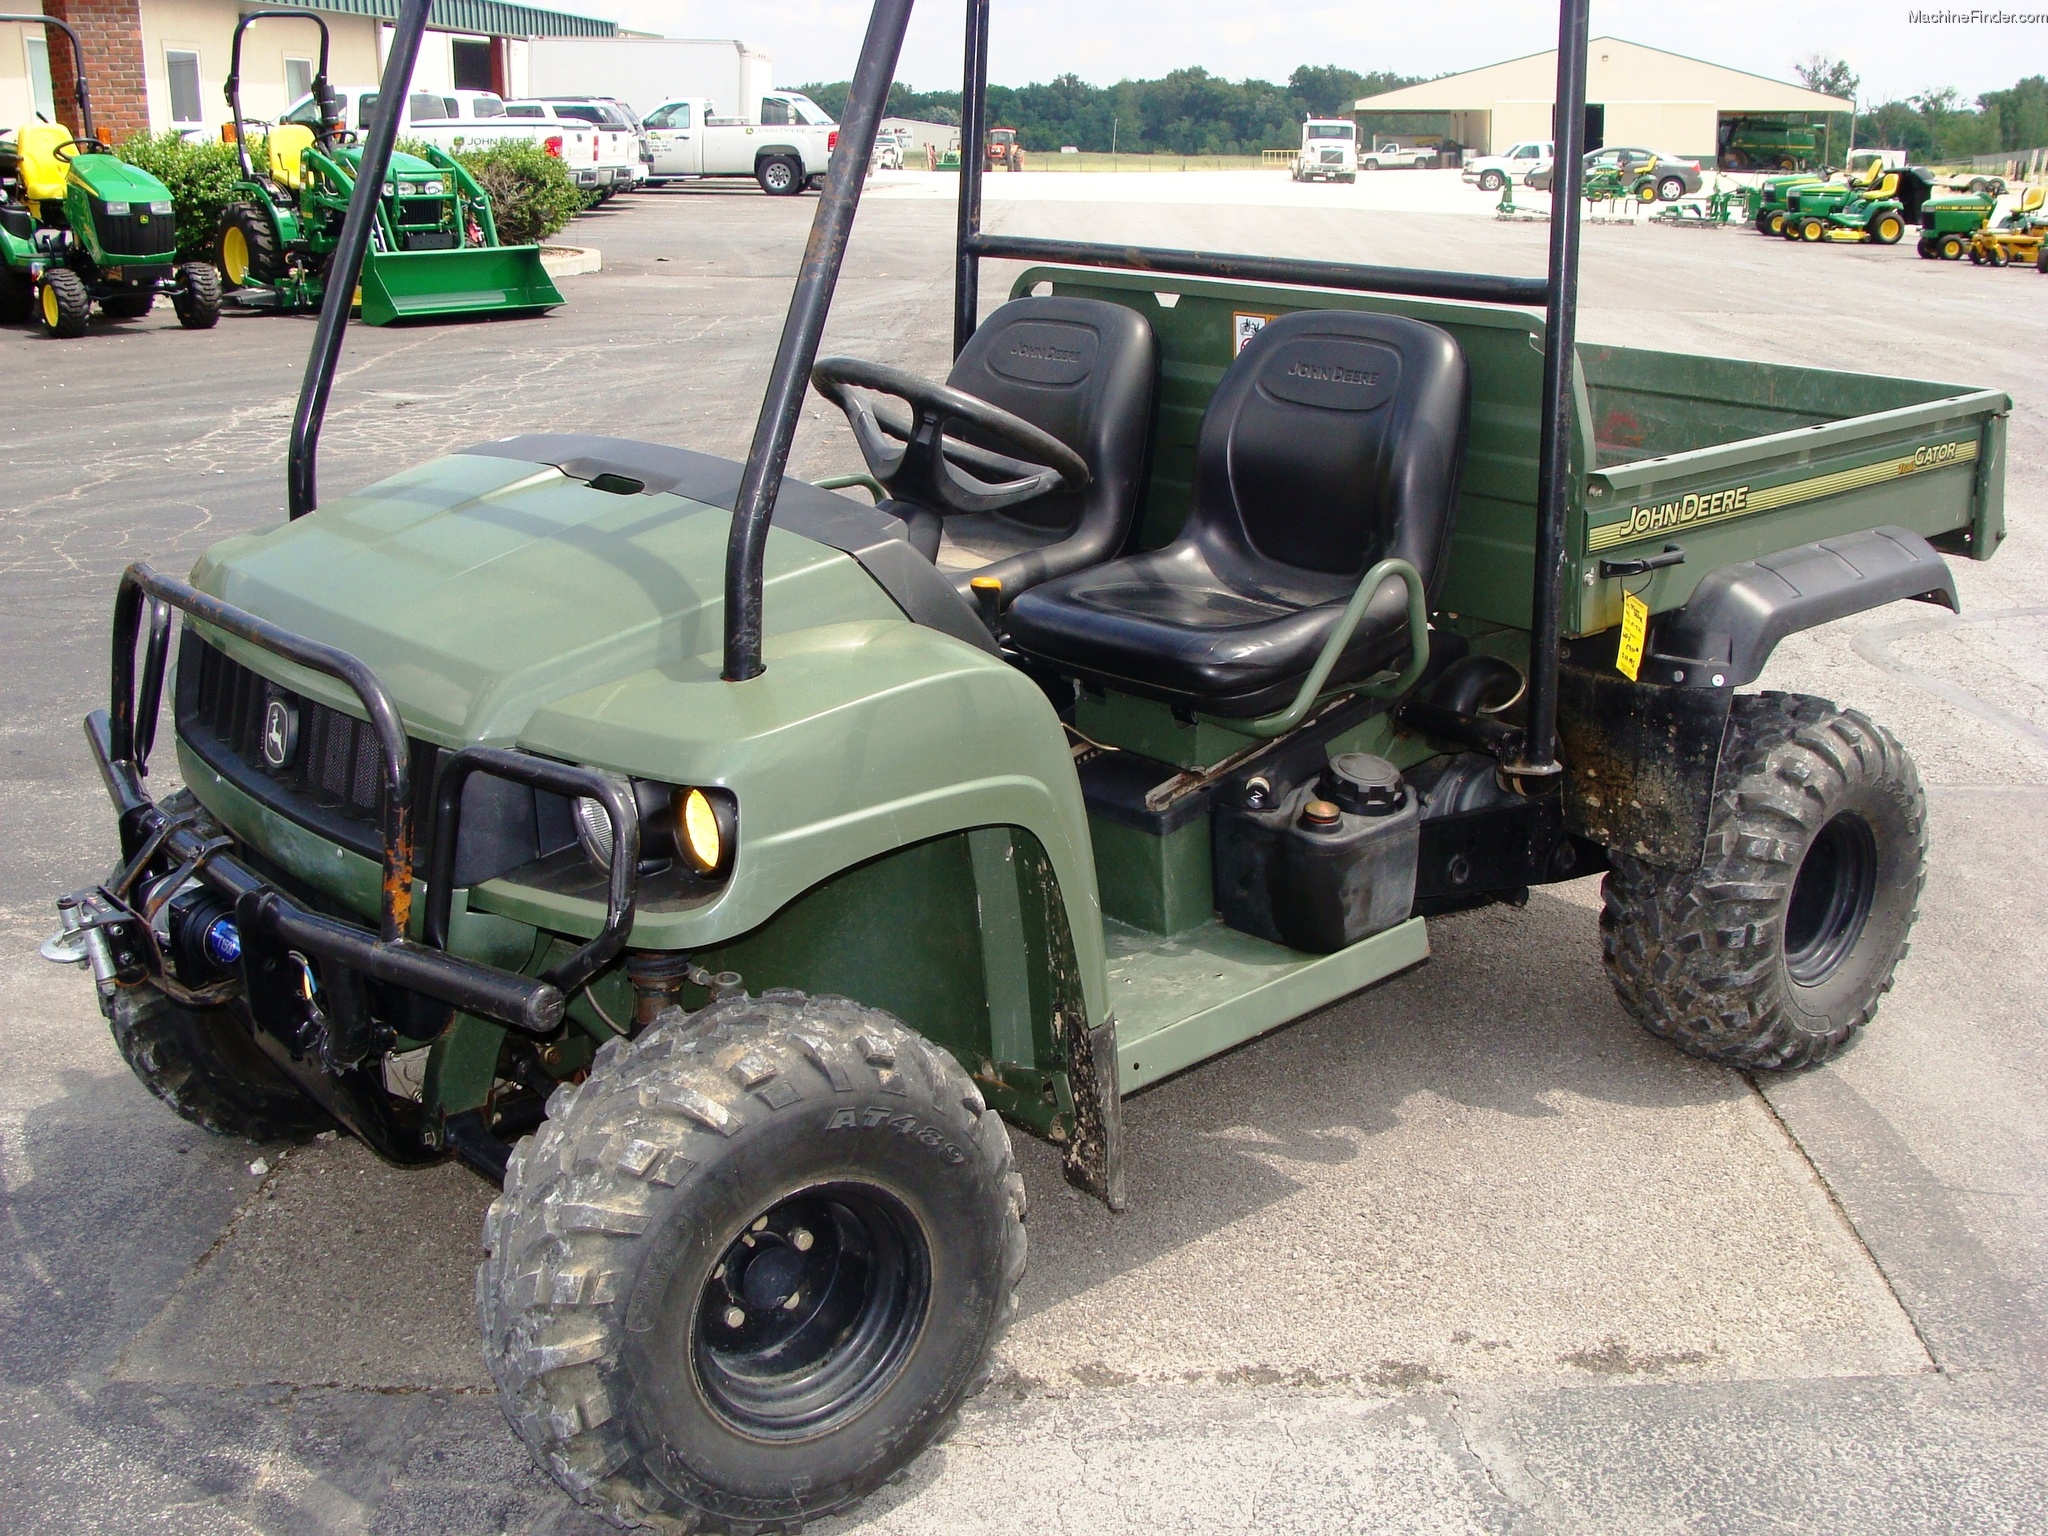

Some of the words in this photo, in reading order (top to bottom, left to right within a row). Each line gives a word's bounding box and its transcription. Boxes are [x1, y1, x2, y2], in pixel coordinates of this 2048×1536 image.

[467, 136, 498, 146] JOHN
[1010, 342, 1044, 359] JOHN
[1044, 346, 1081, 363] DEERE
[1288, 361, 1330, 380] JOHN
[1331, 366, 1379, 386] DEERE
[1914, 441, 1957, 467] GATOR
[1619, 502, 1680, 537] JOHN
[1679, 485, 1750, 523] DEERE
[825, 1105, 966, 1165] AT489
